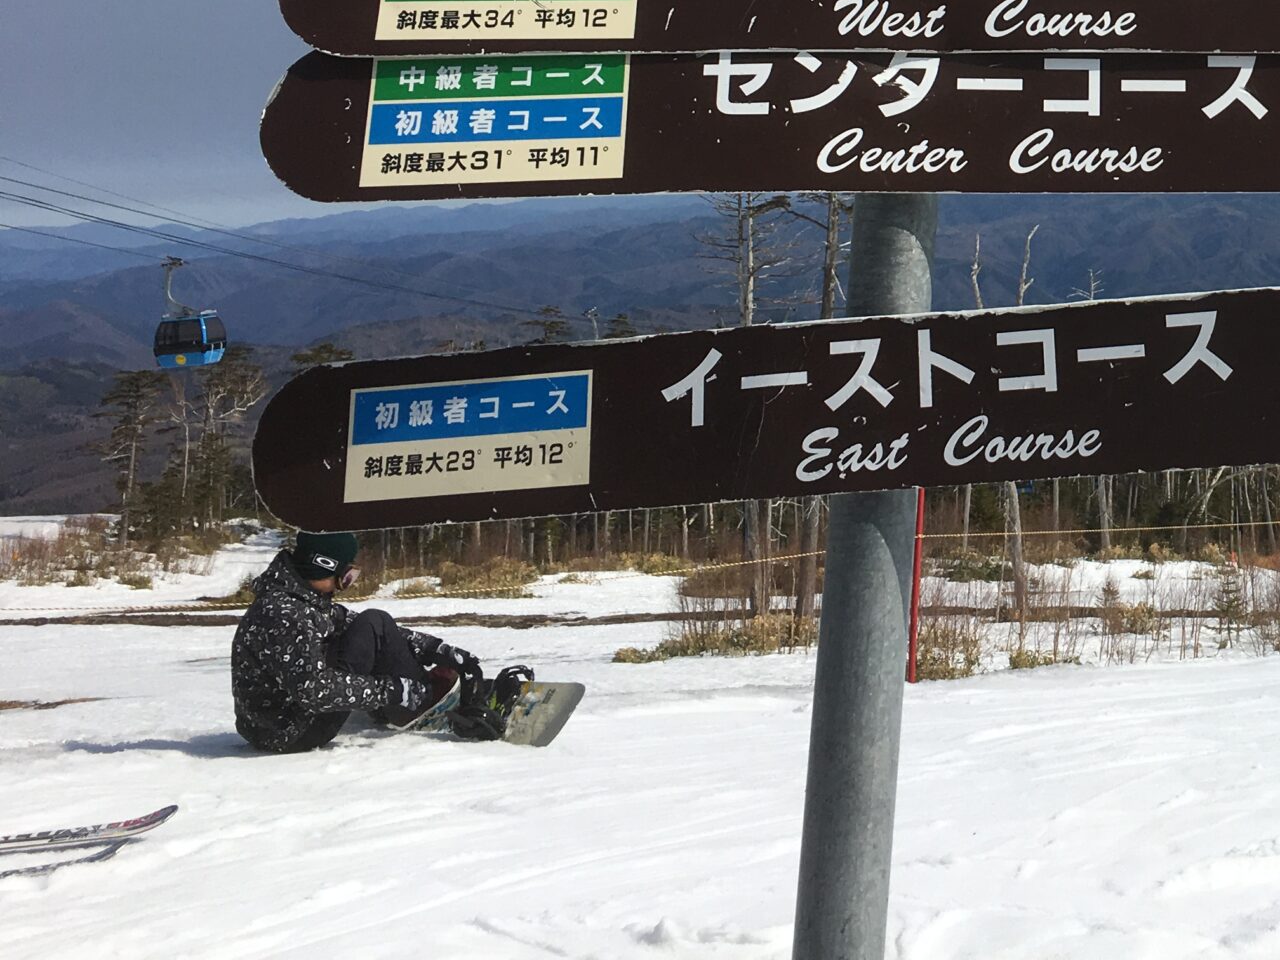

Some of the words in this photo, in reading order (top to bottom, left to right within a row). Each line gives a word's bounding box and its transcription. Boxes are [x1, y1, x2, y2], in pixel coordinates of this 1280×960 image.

[399, 63, 606, 92] 中級者コース
[702, 51, 1269, 120] センターコース
[394, 107, 604, 136] 初級者コース
[816, 127, 969, 174] Center
[1009, 128, 1164, 174] Course
[660, 310, 1234, 427] イーストコース
[375, 389, 569, 430] 初級者コース
[796, 426, 909, 482] East
[942, 414, 1102, 467] Course
